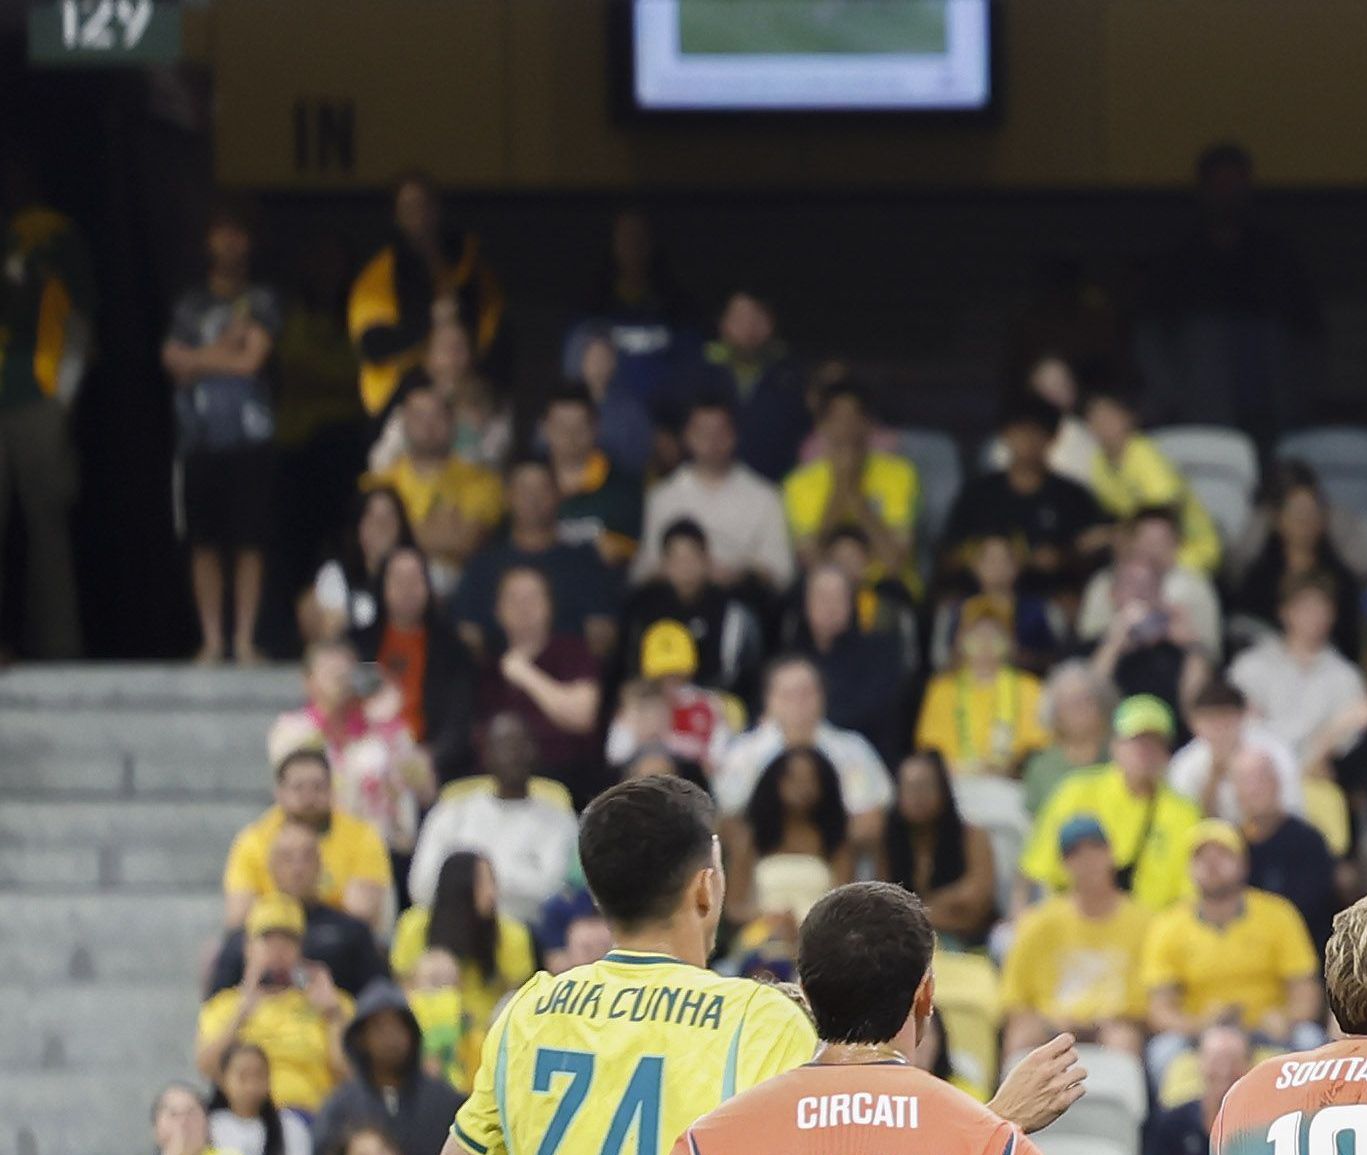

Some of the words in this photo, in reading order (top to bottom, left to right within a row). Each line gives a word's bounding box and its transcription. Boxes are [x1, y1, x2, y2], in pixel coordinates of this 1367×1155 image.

[294, 100, 355, 172] IN
[535, 980, 605, 1018] JAIR
[608, 986, 725, 1030] CUNHA
[797, 1092, 919, 1129] CIRCATI
